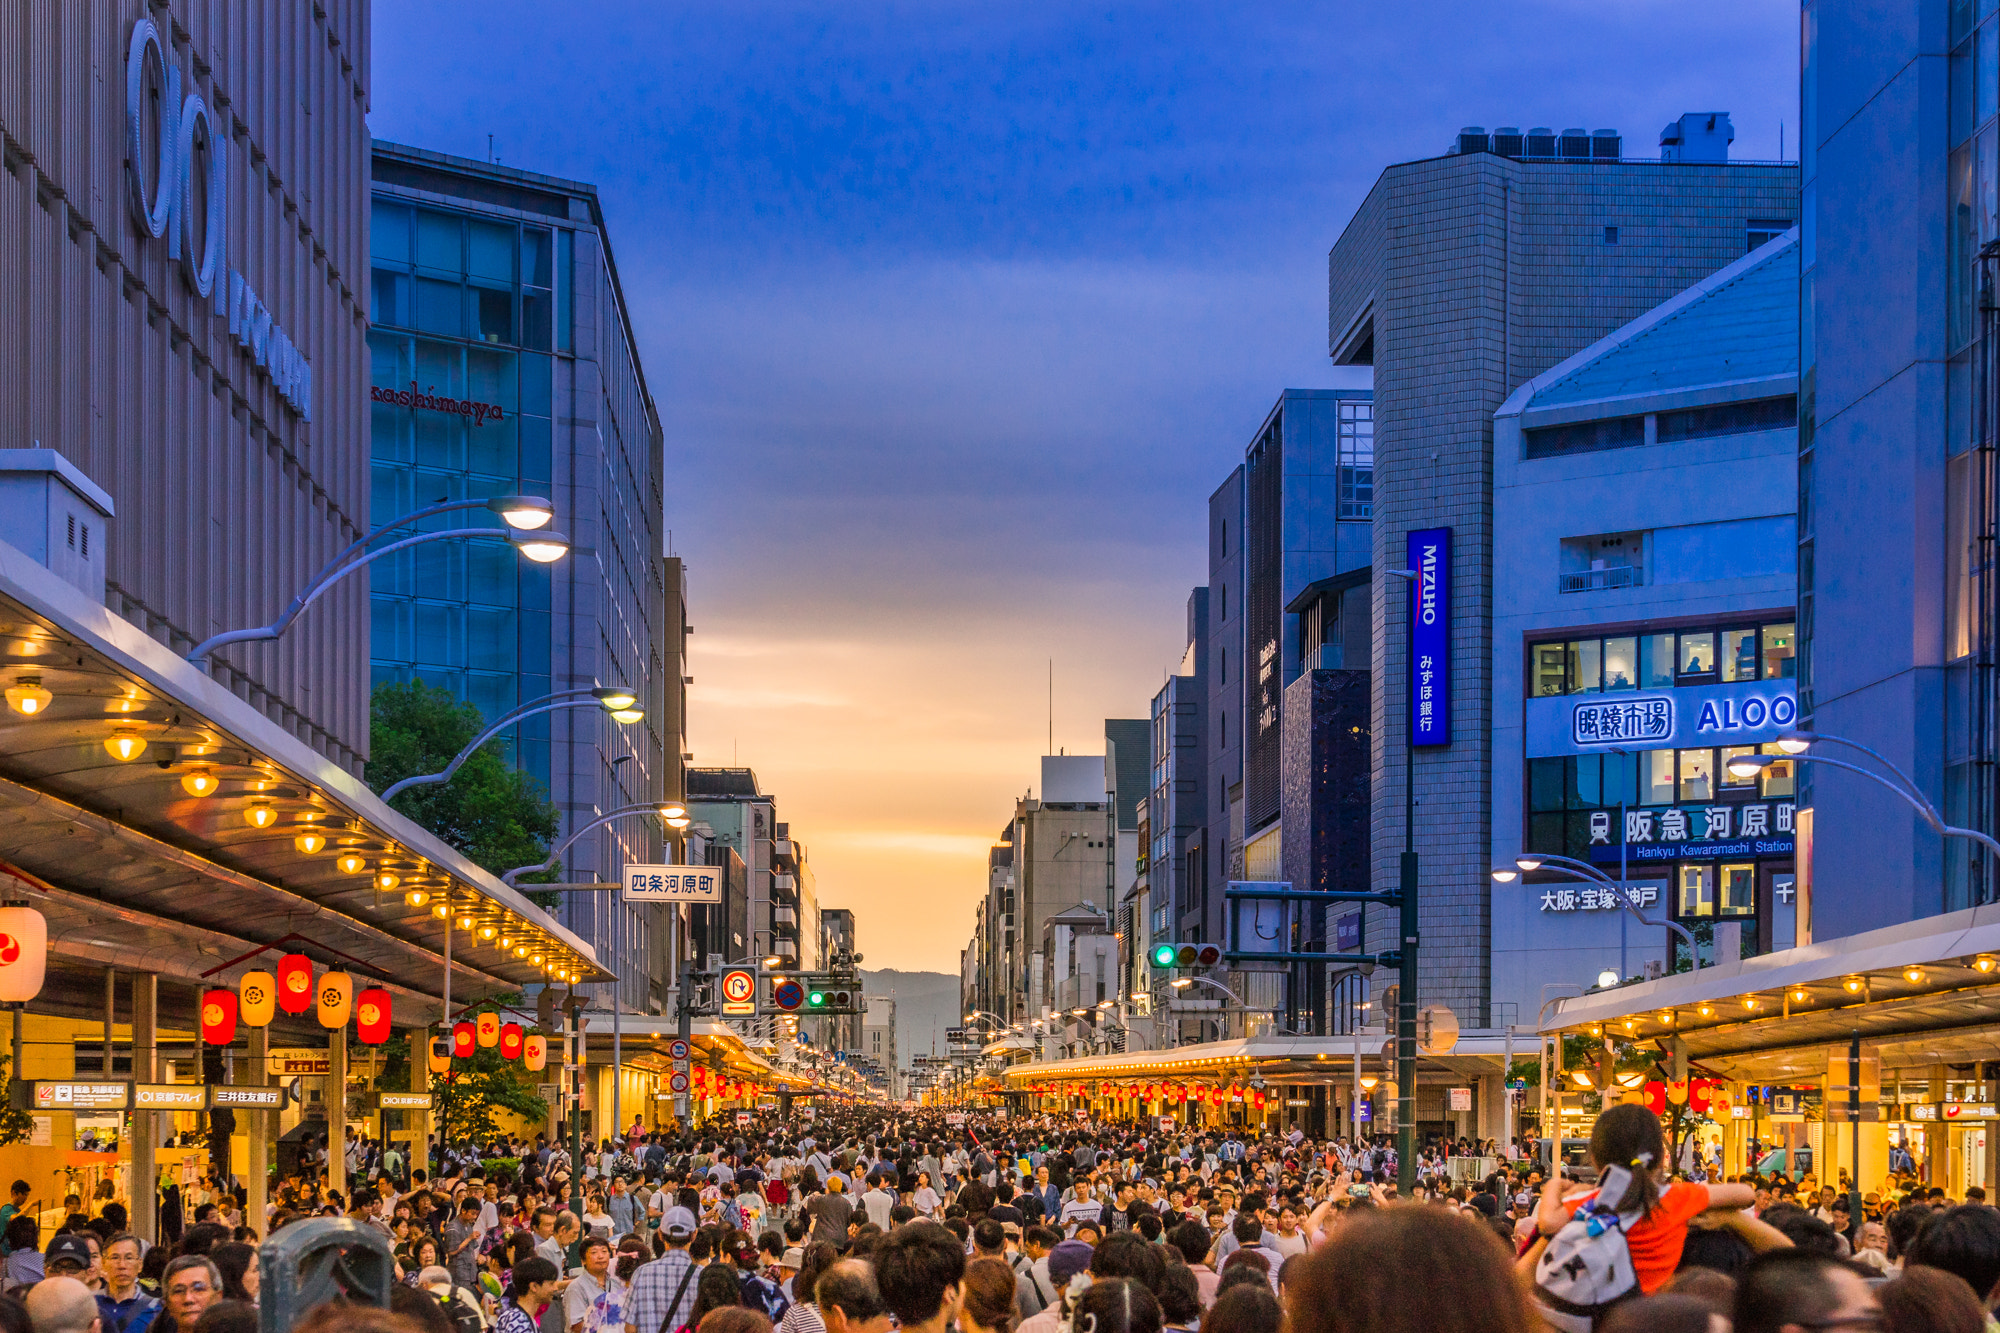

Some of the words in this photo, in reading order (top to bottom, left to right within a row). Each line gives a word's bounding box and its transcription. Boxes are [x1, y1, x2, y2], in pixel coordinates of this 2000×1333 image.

[1422, 544, 1437, 625] MIZUHO
[1419, 655, 1433, 732] みずほ銀行
[1577, 702, 1667, 739] 眼鏡市場
[1626, 809, 1688, 843] 阪急
[1636, 846, 1675, 860] Hankyu
[1680, 842, 1750, 857] Kawaramachi
[1755, 840, 1792, 853] Station
[631, 873, 714, 895] 四条河原町
[155, 1092, 202, 1102] 京都マルイ
[217, 1091, 278, 1103] 三井住友銀行
[400, 1096, 430, 1105] 京都マルイ
